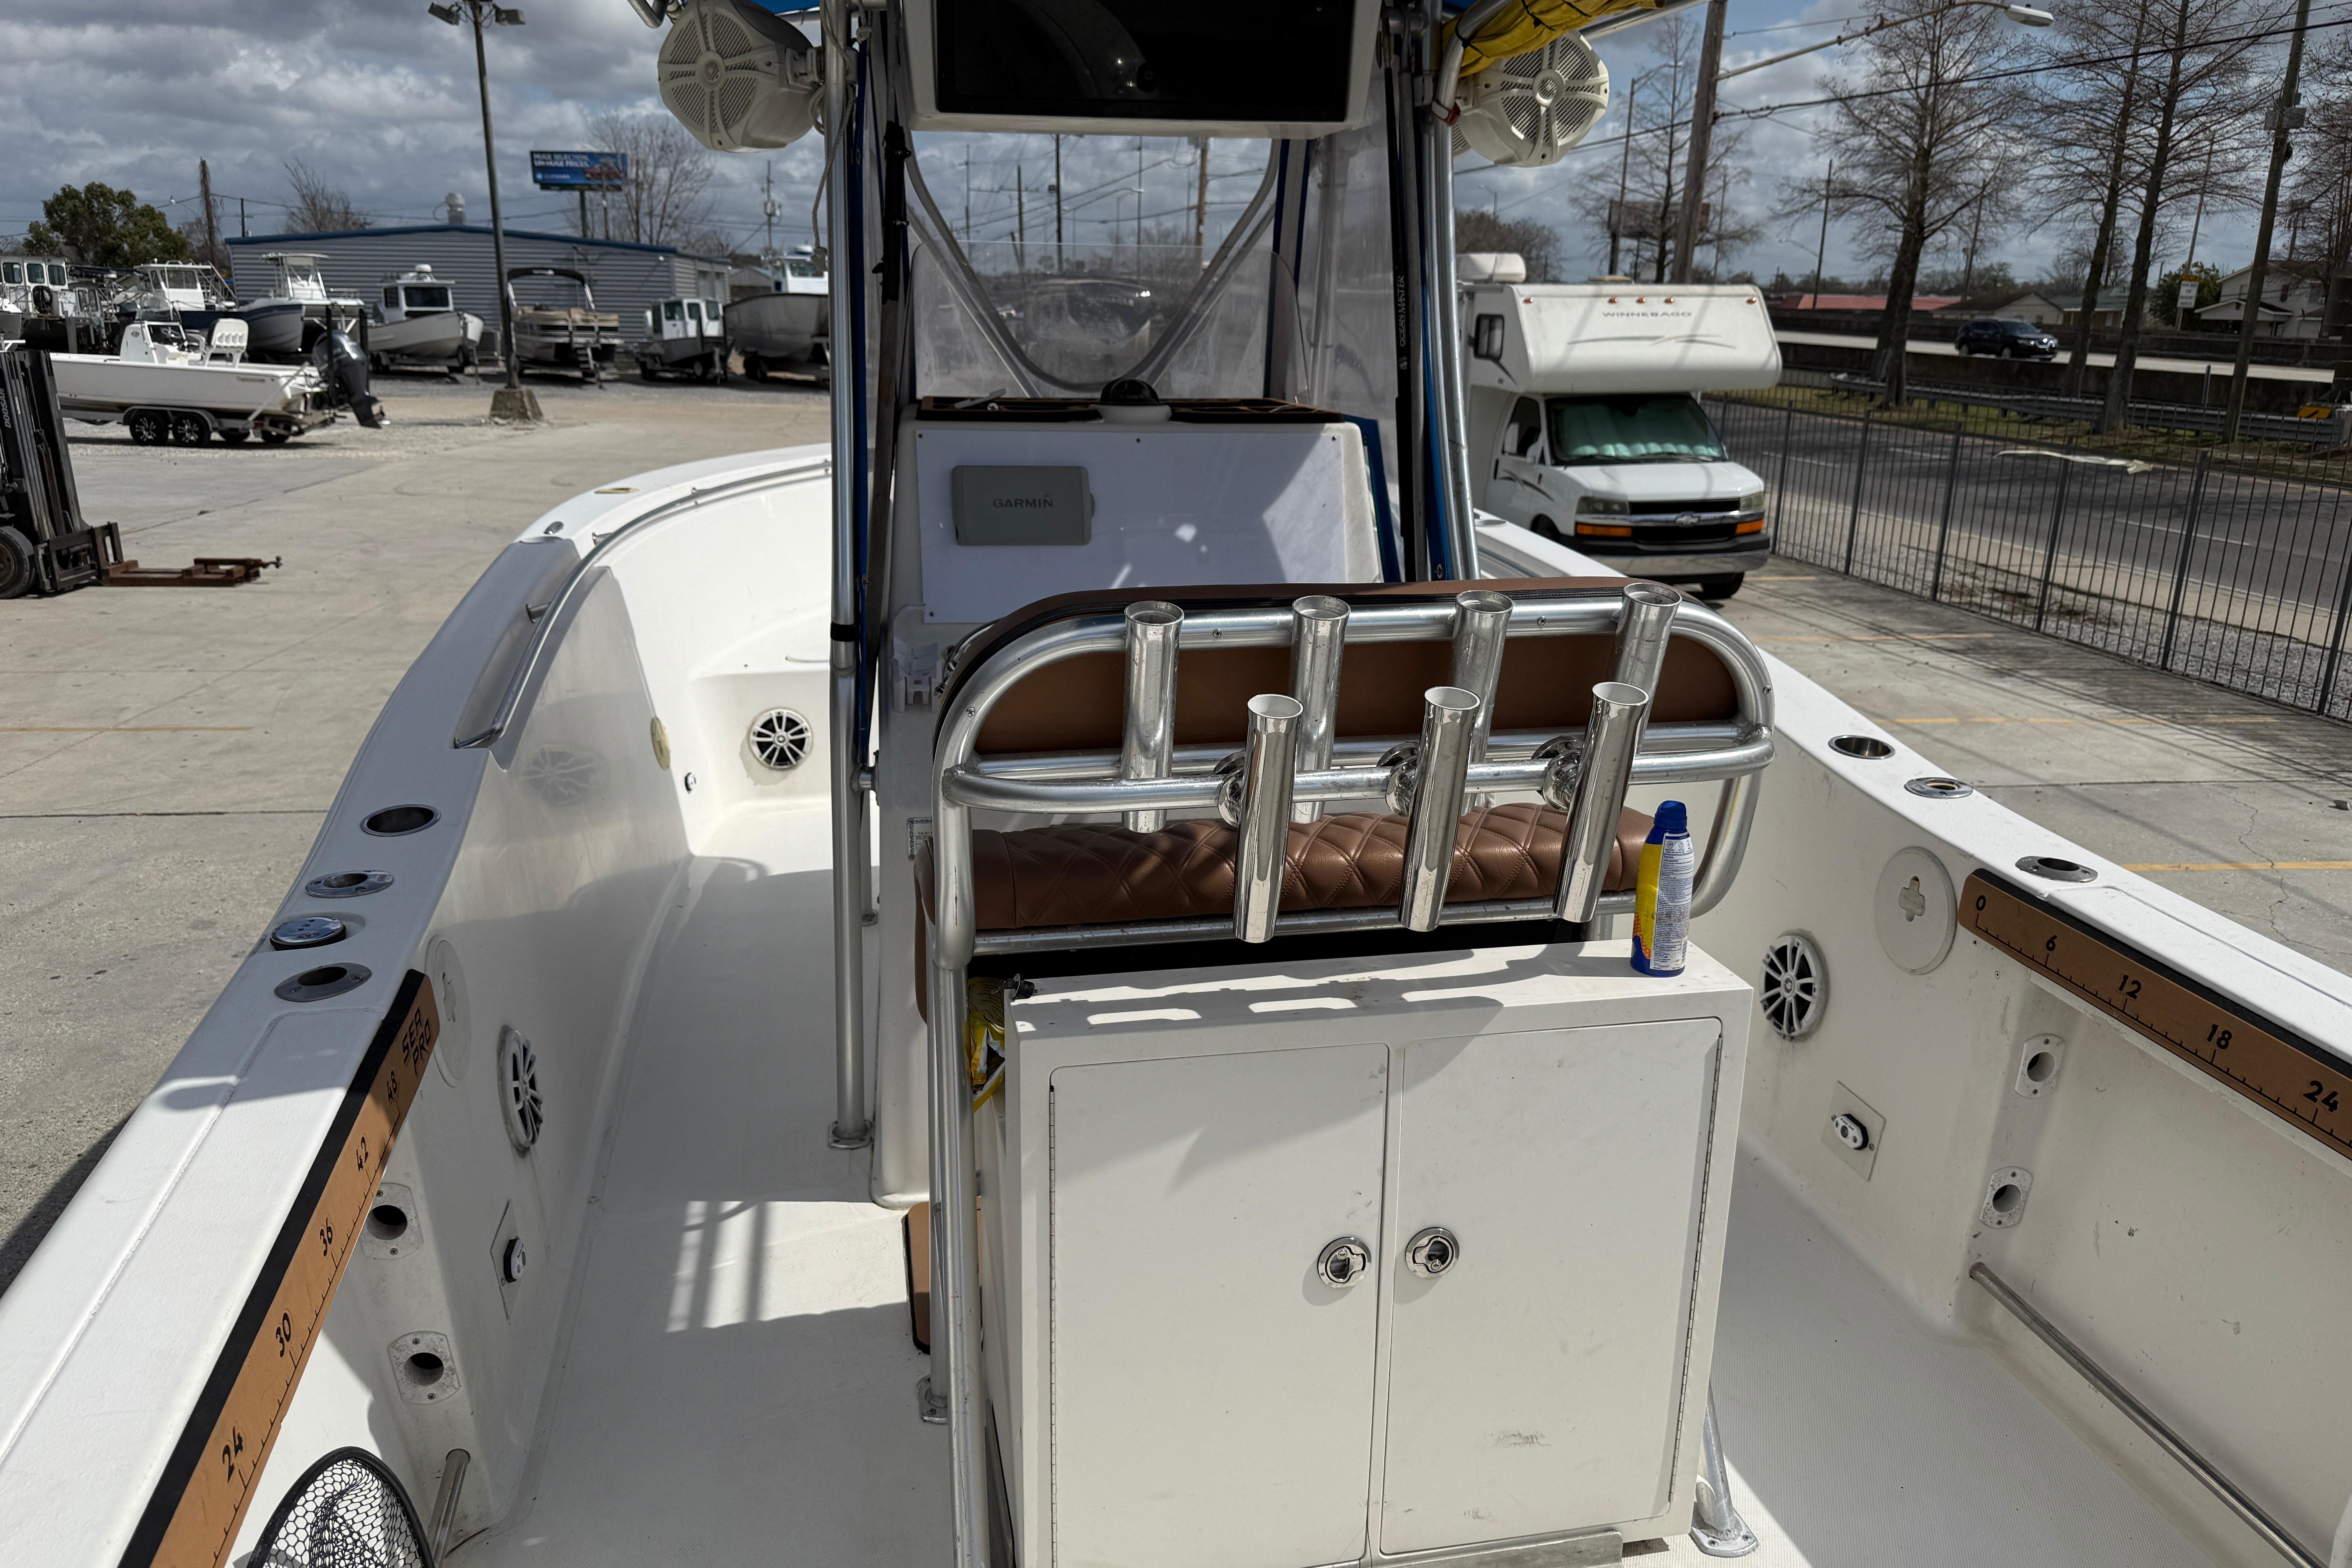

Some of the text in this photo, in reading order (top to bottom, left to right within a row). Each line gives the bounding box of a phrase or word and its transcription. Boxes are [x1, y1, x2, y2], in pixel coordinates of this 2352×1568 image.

[1397, 275, 1405, 313] MASTER
[993, 498, 1053, 508] GARMIN
[1976, 895, 1986, 911] 0
[2046, 935, 2057, 951] 6
[2119, 975, 2141, 1000] 12
[402, 1006, 422, 1064] SEA
[413, 1018, 431, 1076] PRO
[2207, 1024, 2232, 1049] 18
[387, 1070, 397, 1103] 48
[2303, 1080, 2338, 1113] 24
[356, 1136, 369, 1172] 42
[320, 1217, 333, 1257] 36
[276, 1312, 292, 1358] 30
[222, 1425, 243, 1483] 24
